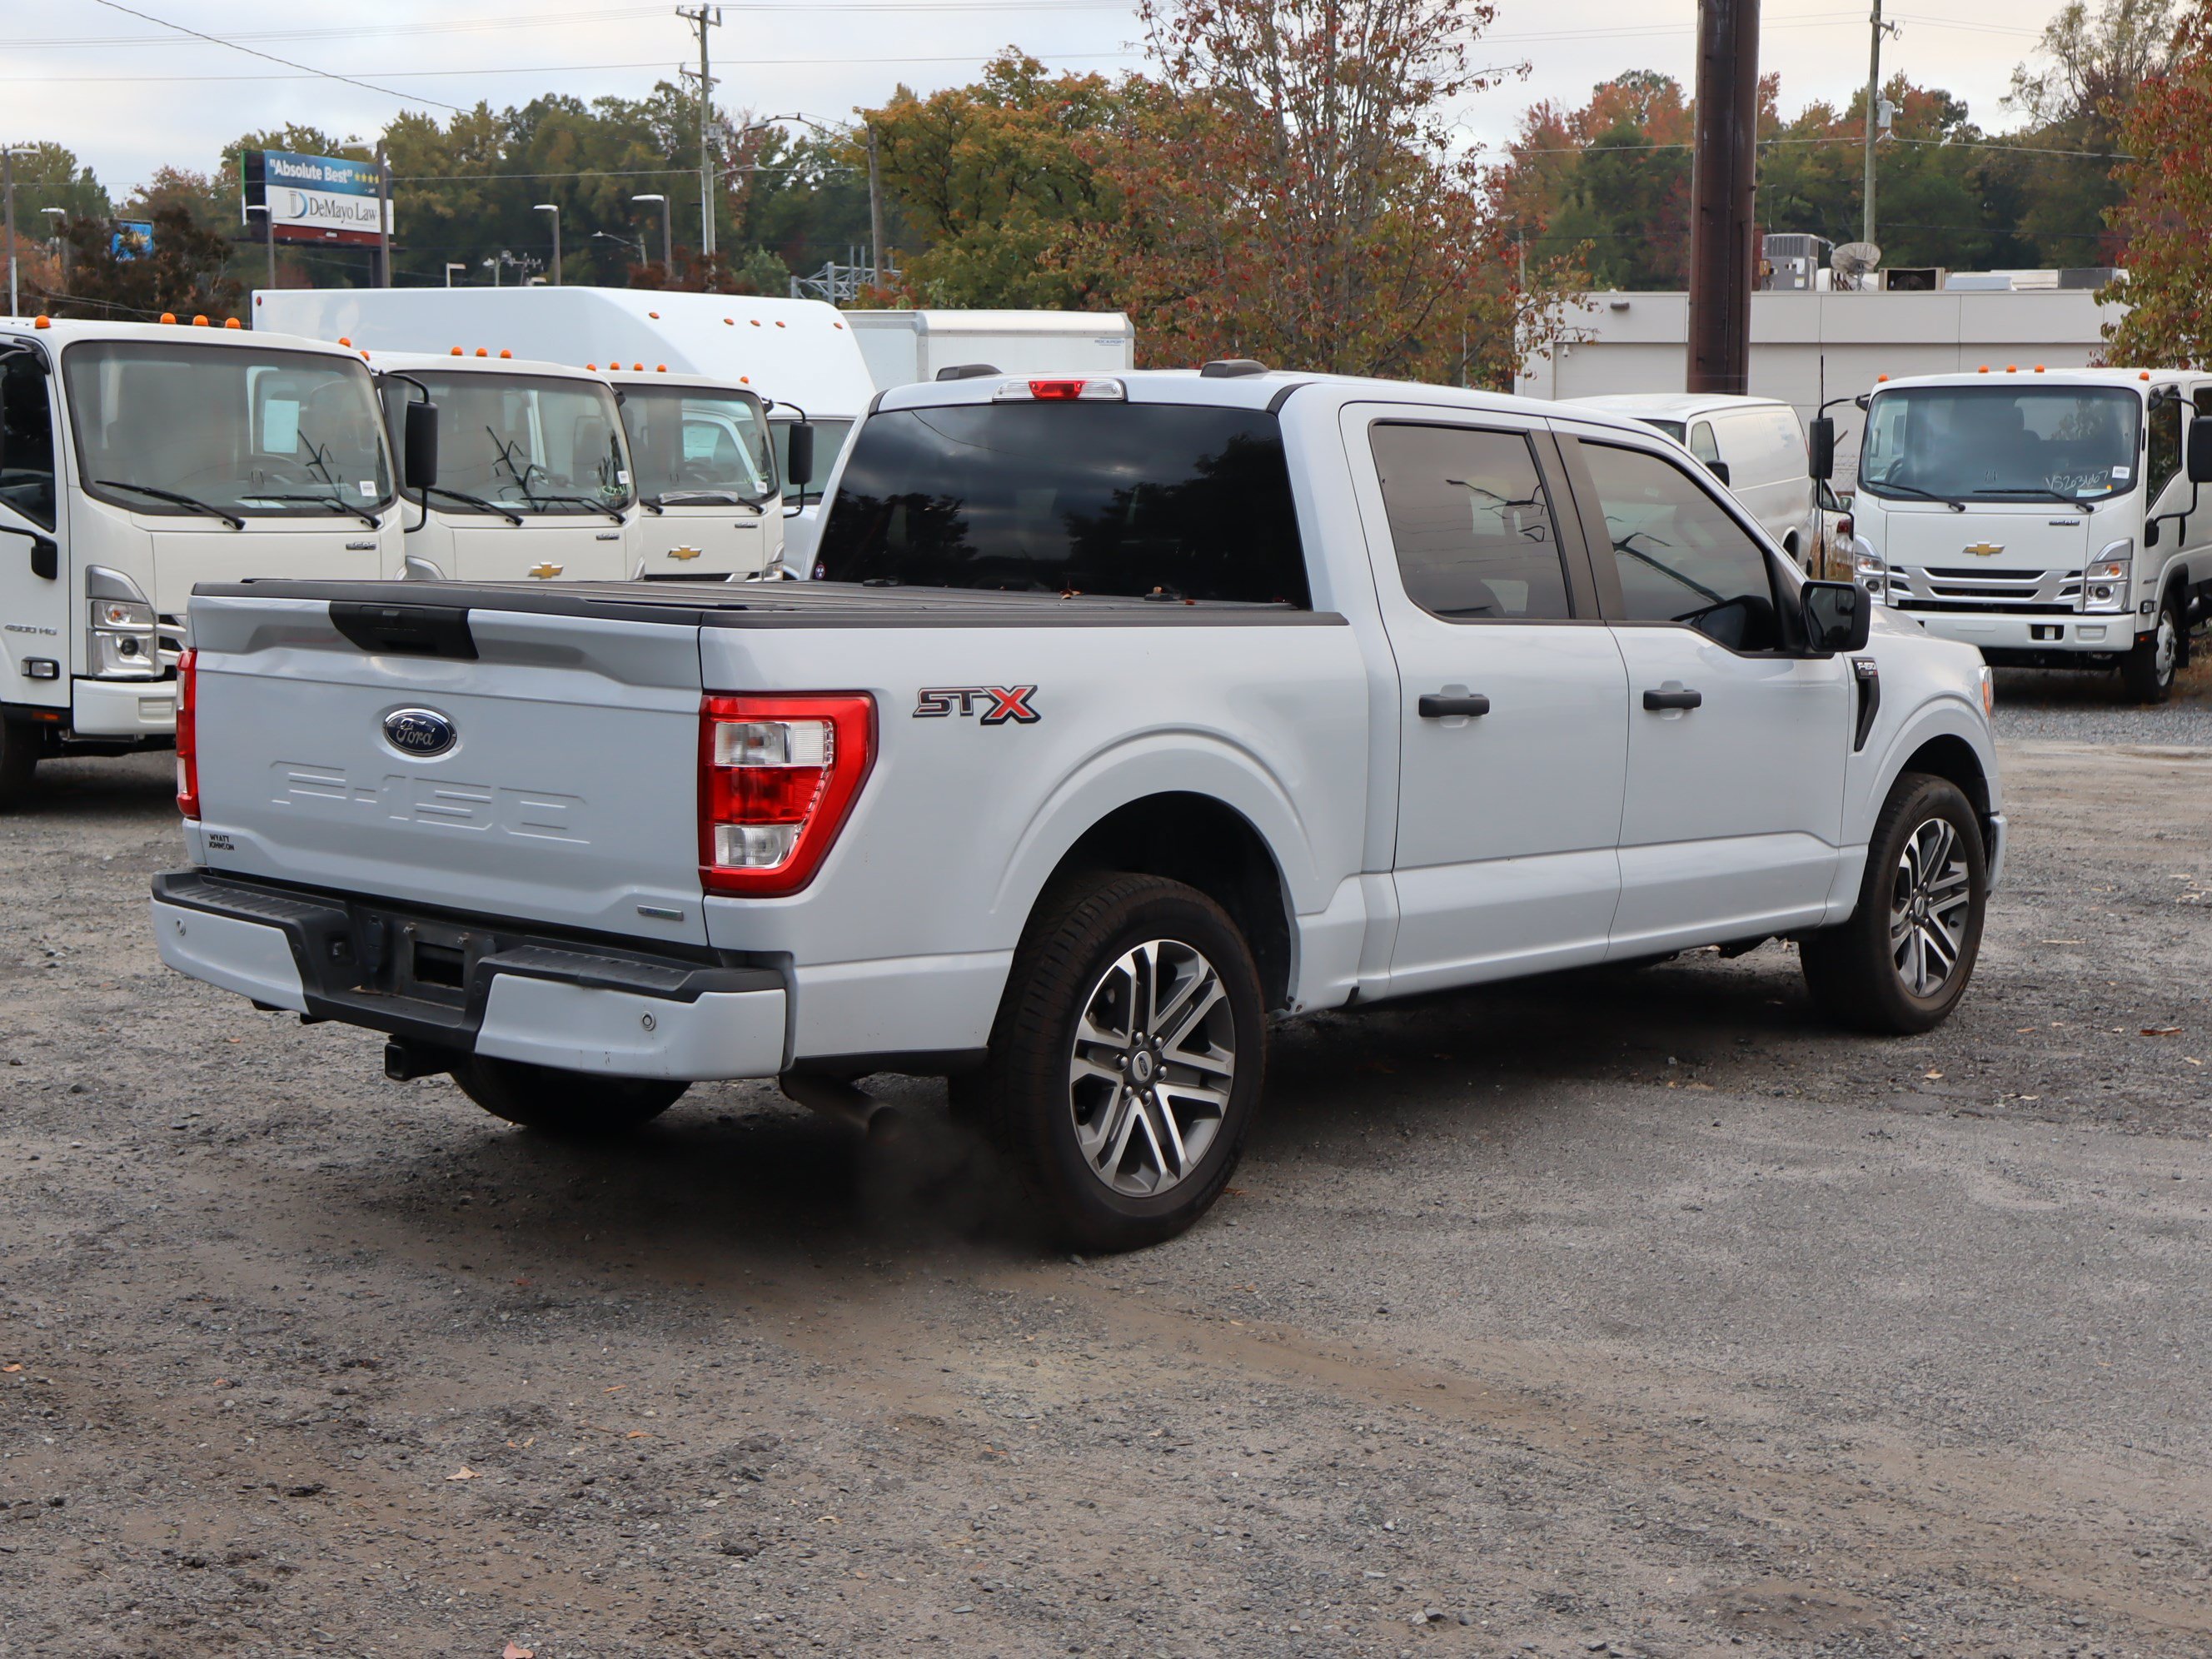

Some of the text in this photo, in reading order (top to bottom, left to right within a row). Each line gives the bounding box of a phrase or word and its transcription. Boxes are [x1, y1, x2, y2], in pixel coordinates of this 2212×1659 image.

[310, 197, 377, 223] DeMayo Law
[913, 685, 1041, 725] STX
[396, 717, 436, 746] Ford
[270, 760, 590, 844] F-150
[209, 834, 229, 842] WYATT
